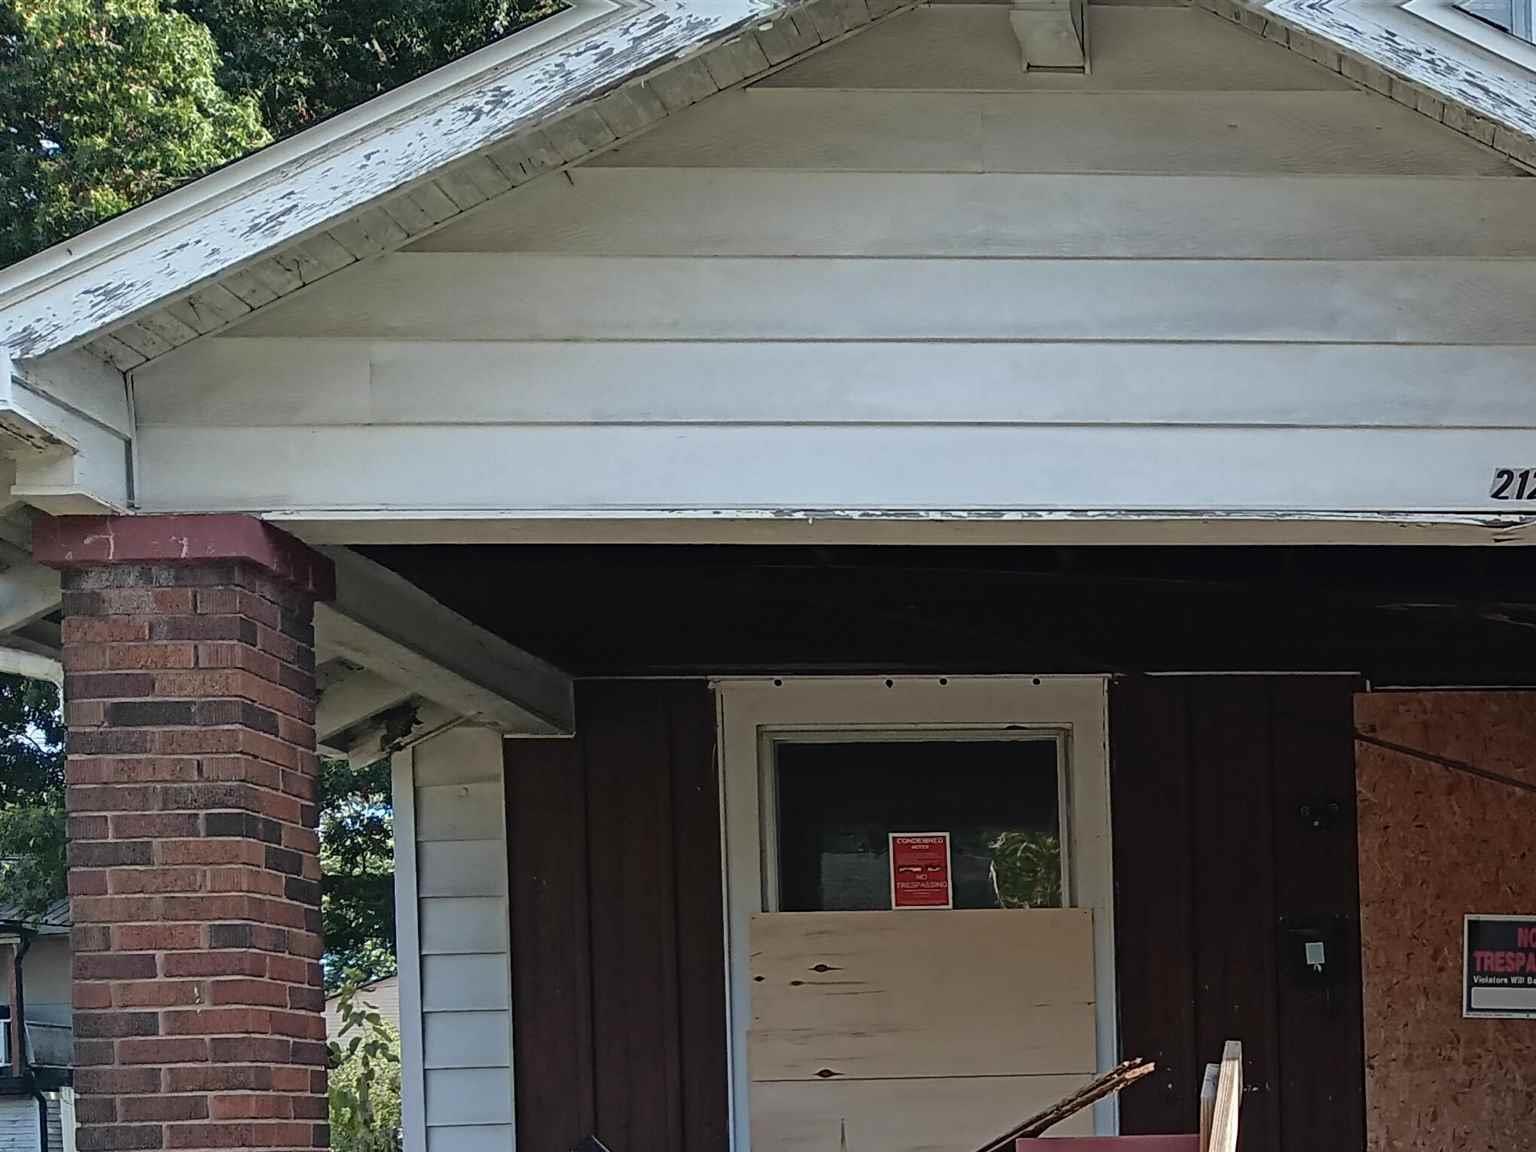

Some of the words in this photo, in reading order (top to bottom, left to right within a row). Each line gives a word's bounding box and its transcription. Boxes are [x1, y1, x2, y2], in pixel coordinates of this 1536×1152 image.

[896, 881, 948, 889] TRESPASSING
[1473, 975, 1508, 985] Violators
[1510, 975, 1525, 985] Will
